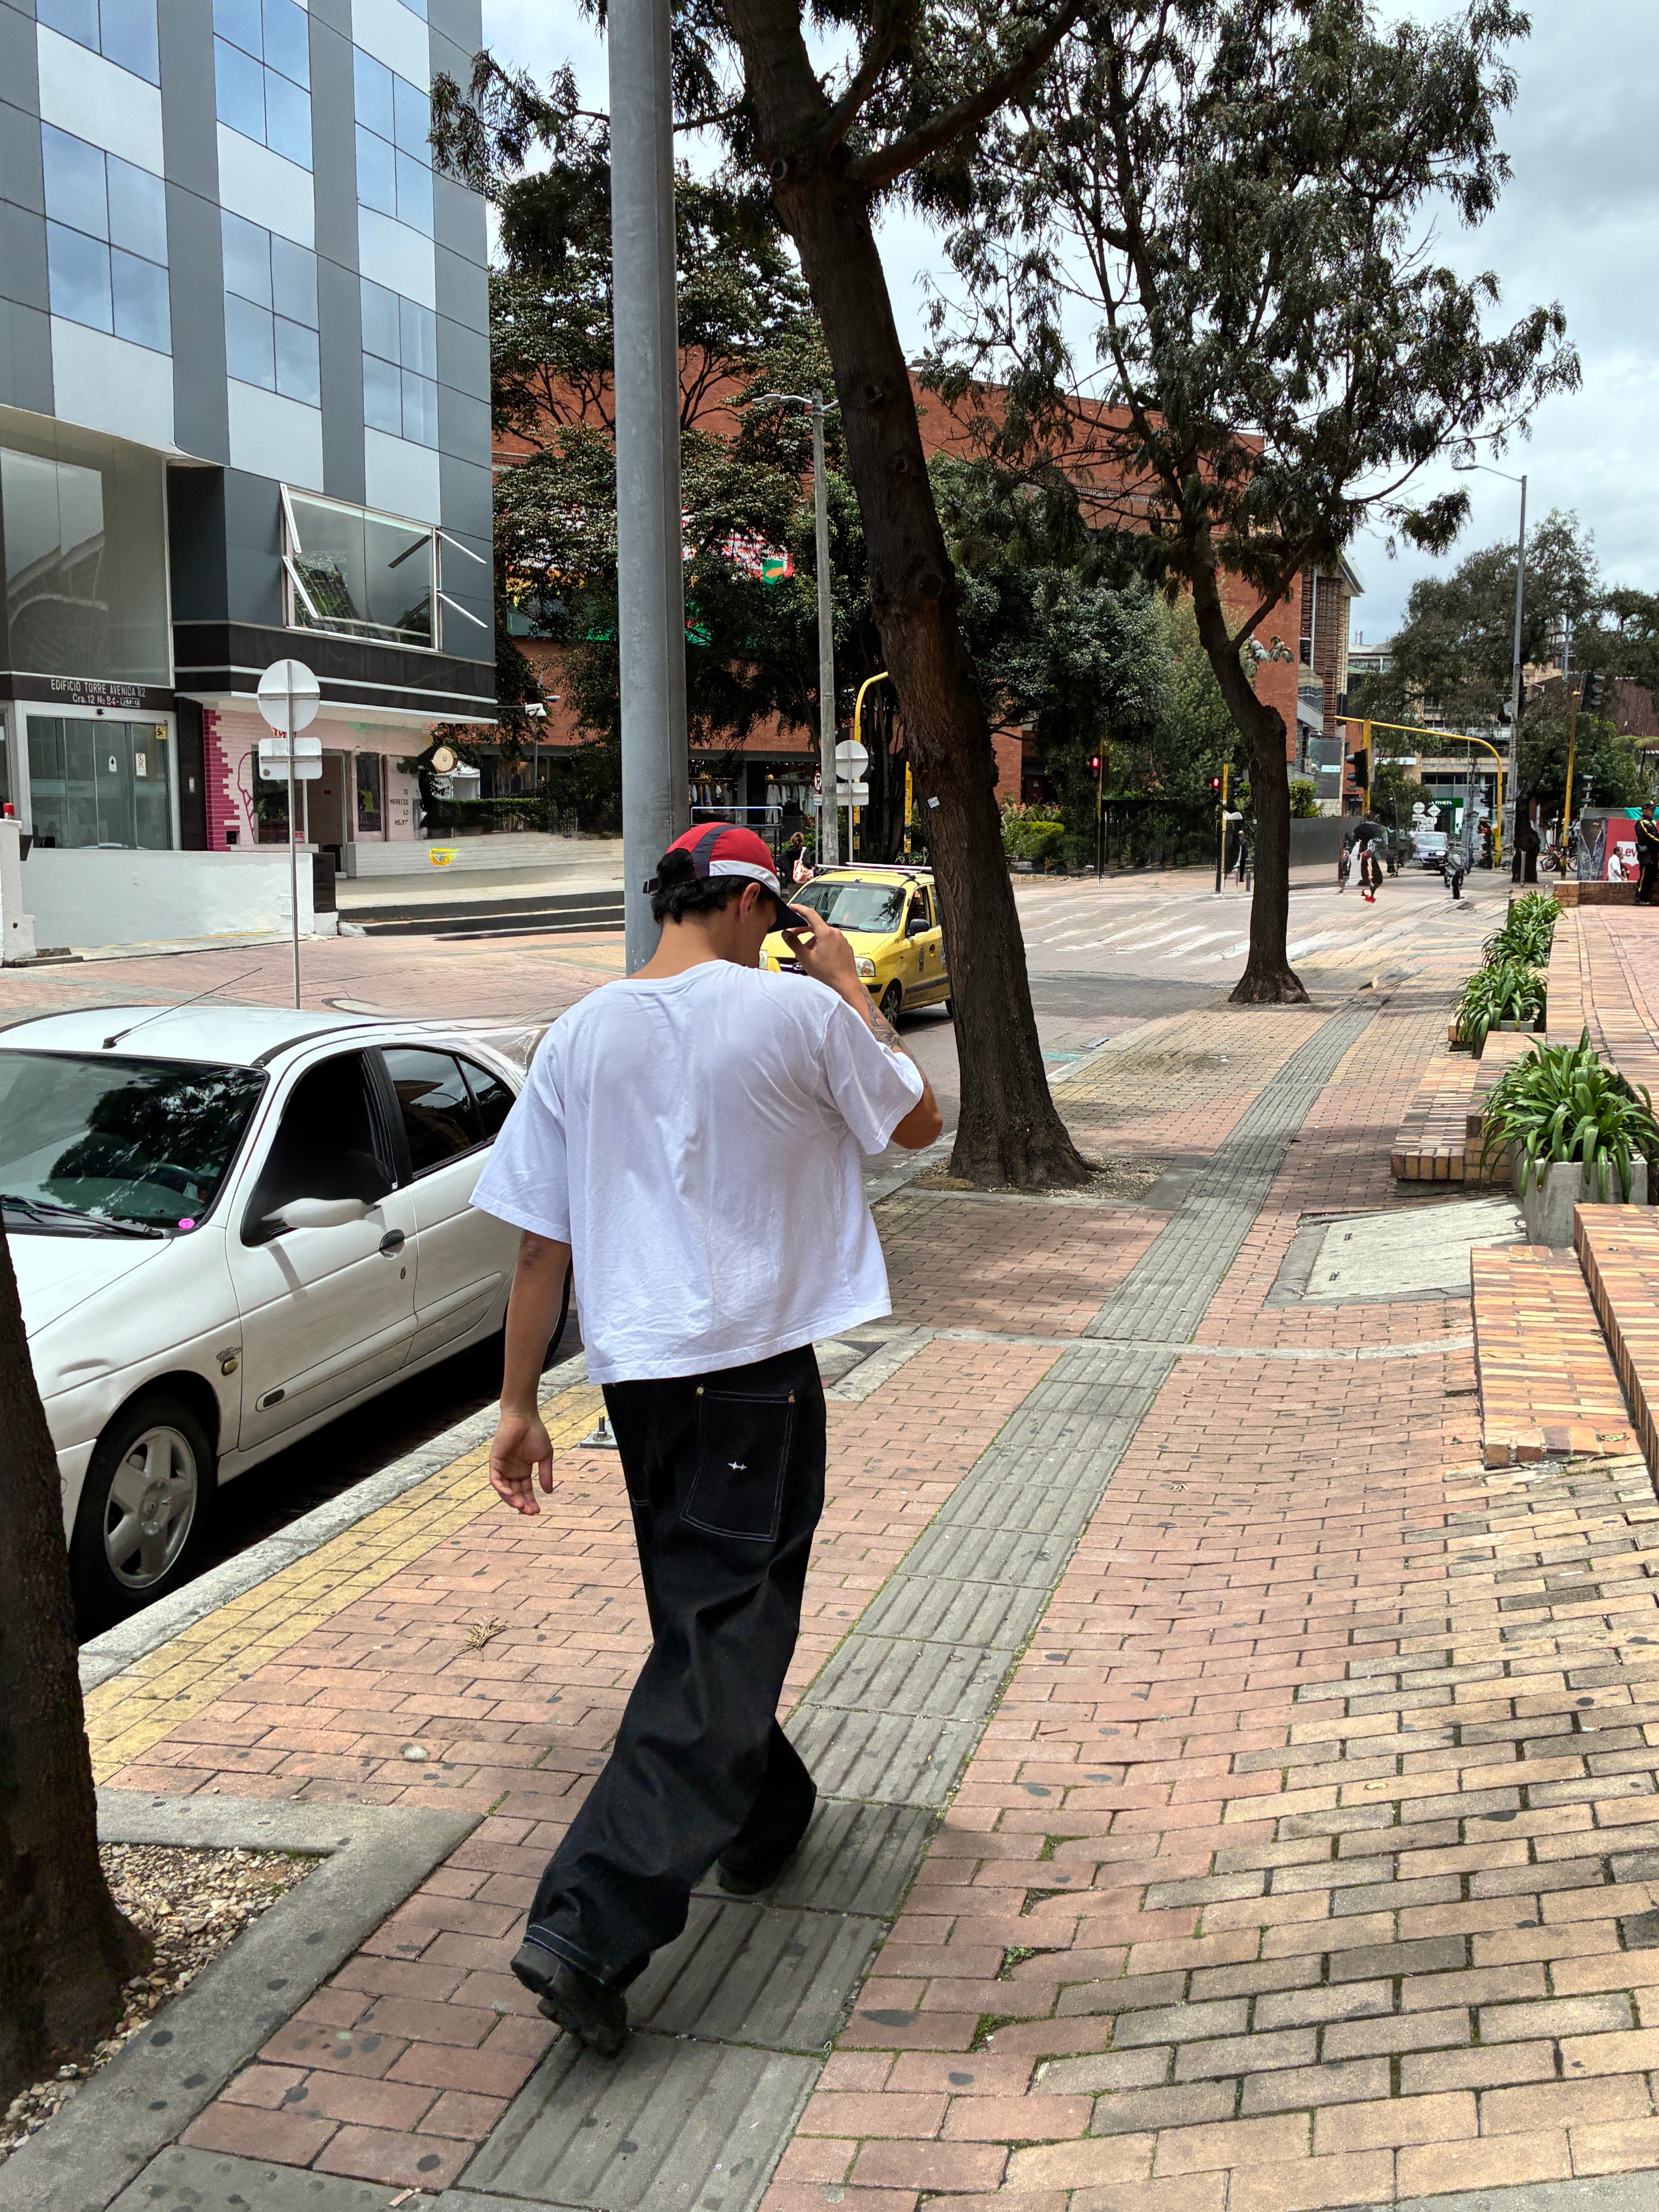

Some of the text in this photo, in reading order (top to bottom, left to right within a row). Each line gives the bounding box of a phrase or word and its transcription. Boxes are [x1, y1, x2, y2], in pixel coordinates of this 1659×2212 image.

[51, 679, 81, 692] EDIFICIO
[84, 682, 107, 694] TORRE
[110, 685, 136, 696] AVENIDA
[88, 695, 95, 704] 12
